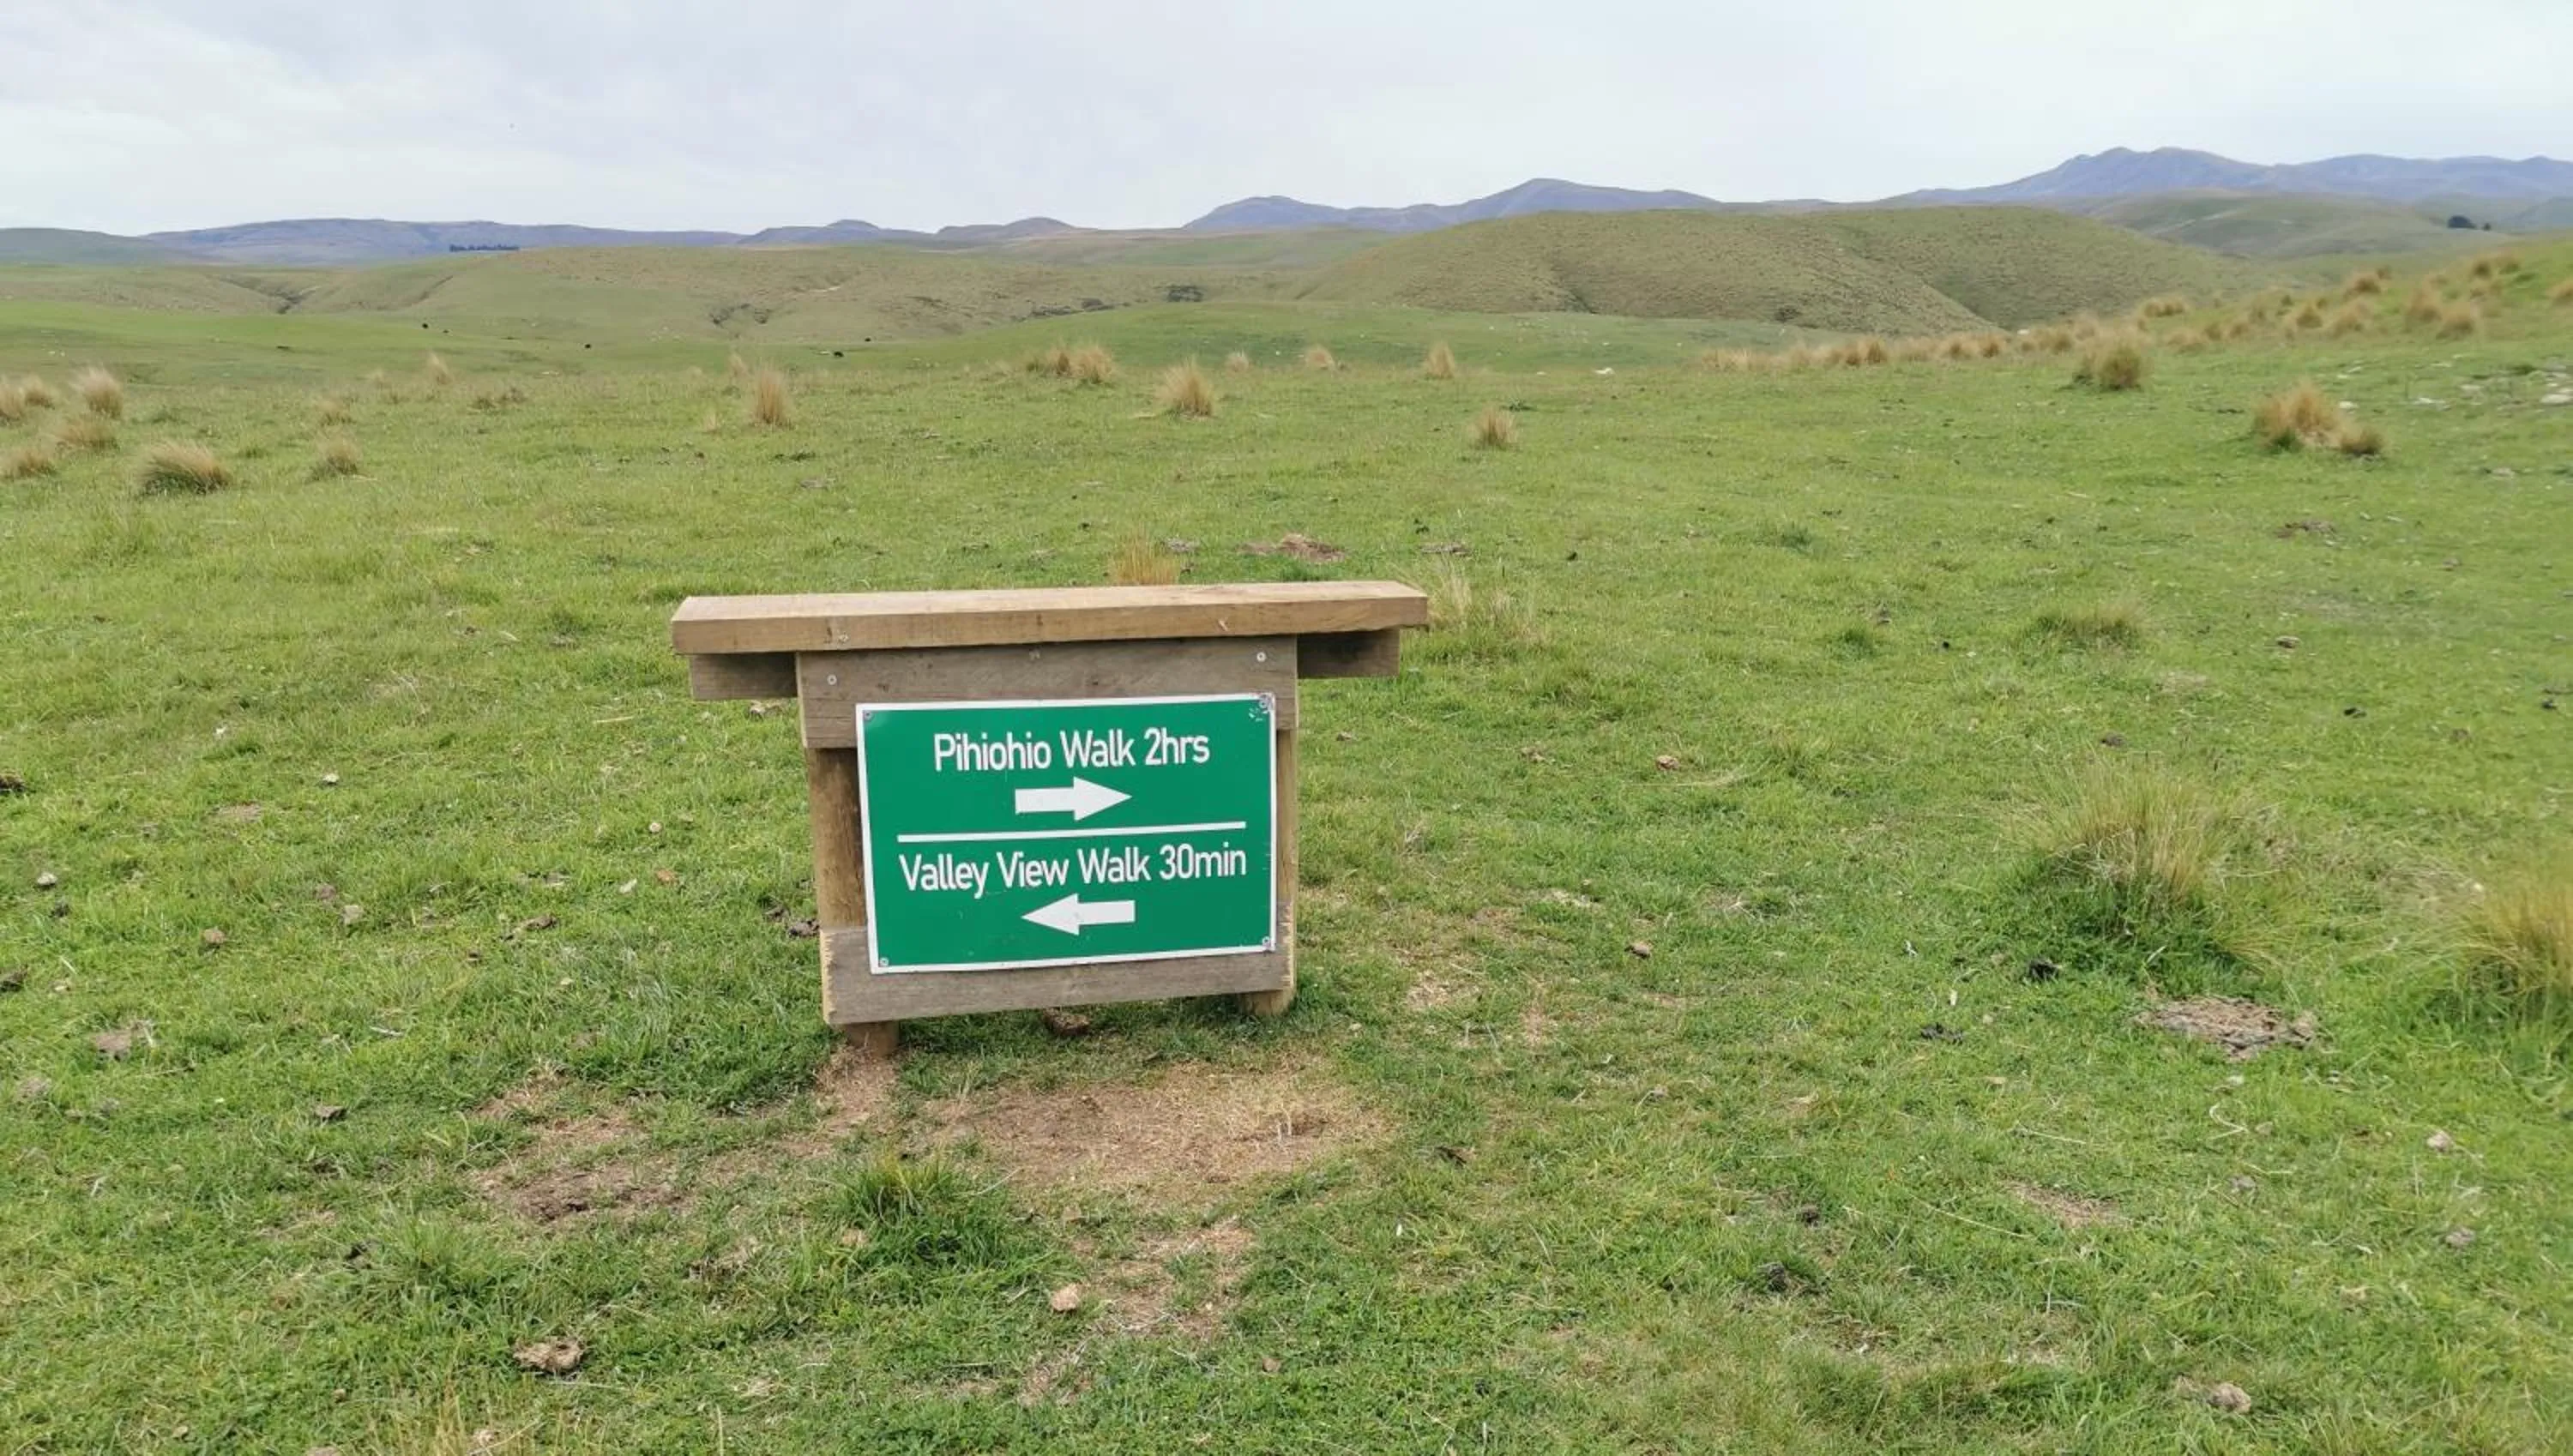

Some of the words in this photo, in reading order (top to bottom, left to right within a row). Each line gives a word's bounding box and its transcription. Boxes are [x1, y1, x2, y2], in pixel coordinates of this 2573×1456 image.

[933, 731, 1051, 772] Pihiohio
[1059, 728, 1136, 768] Walk
[1144, 727, 1210, 766] 2hrs
[899, 852, 989, 899] Valley
[996, 851, 1070, 888] View
[1077, 845, 1151, 884] Walk
[1160, 841, 1247, 880] 30min
